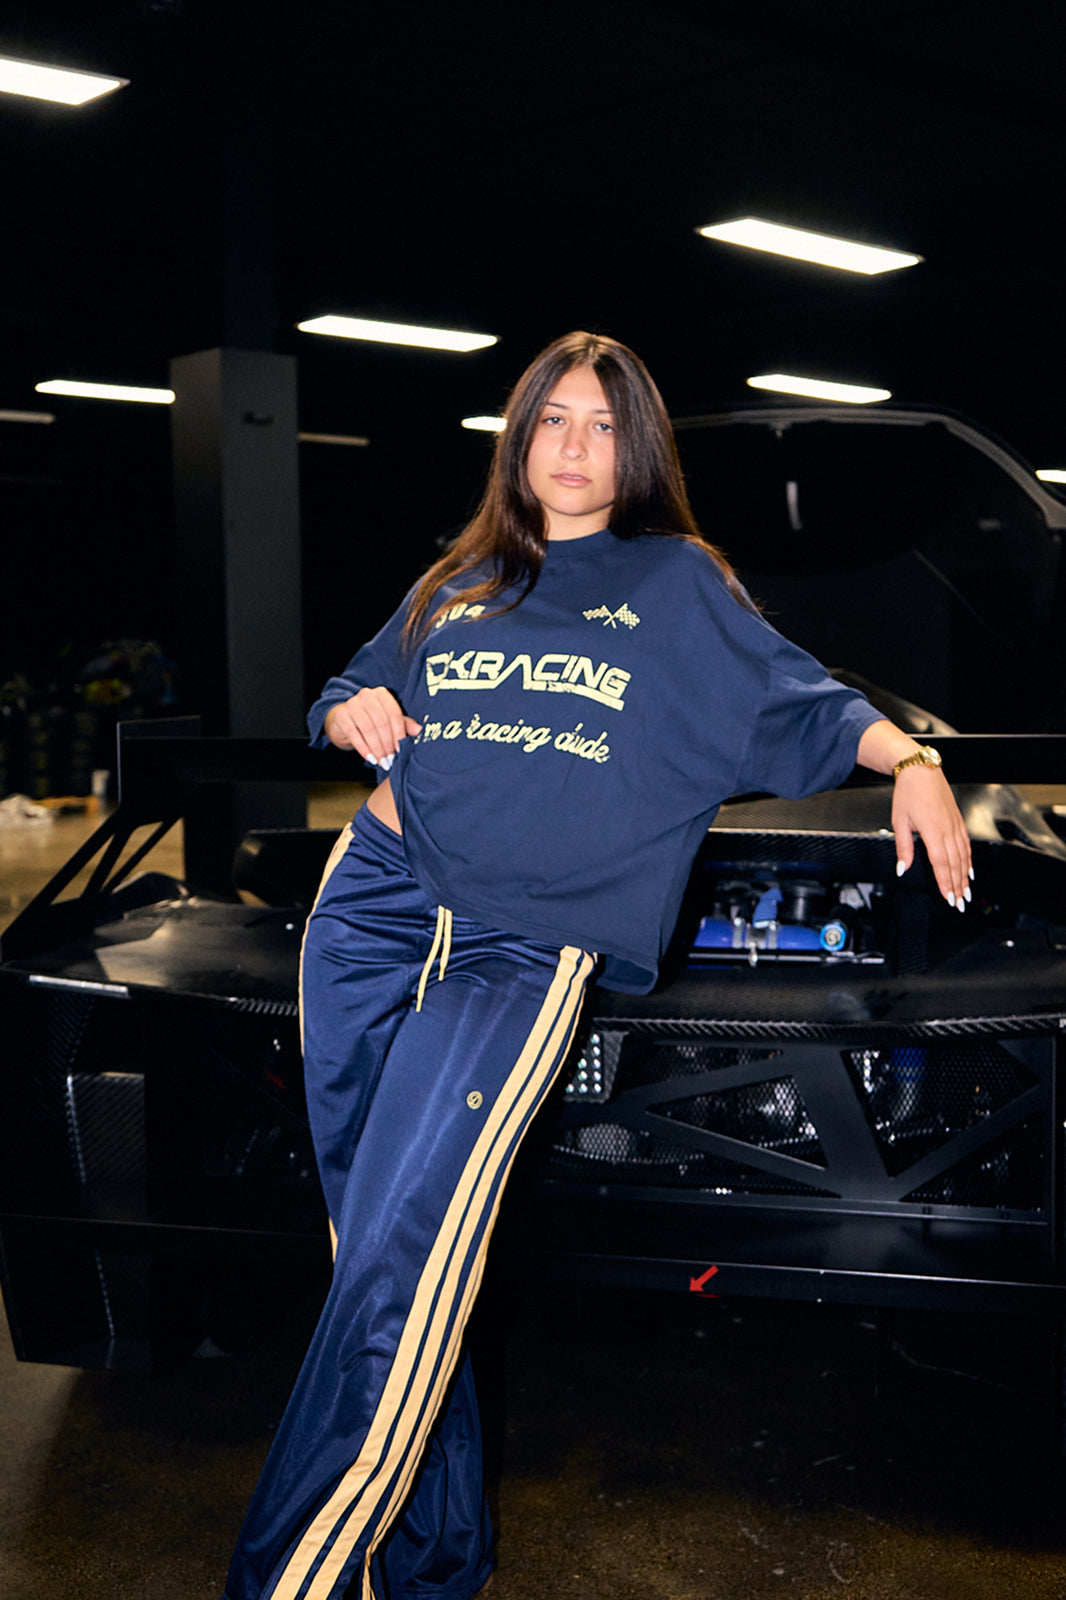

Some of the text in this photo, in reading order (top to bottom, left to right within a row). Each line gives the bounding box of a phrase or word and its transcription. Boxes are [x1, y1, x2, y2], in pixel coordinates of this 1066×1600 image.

[413, 713, 611, 764] 'm a racing dude
